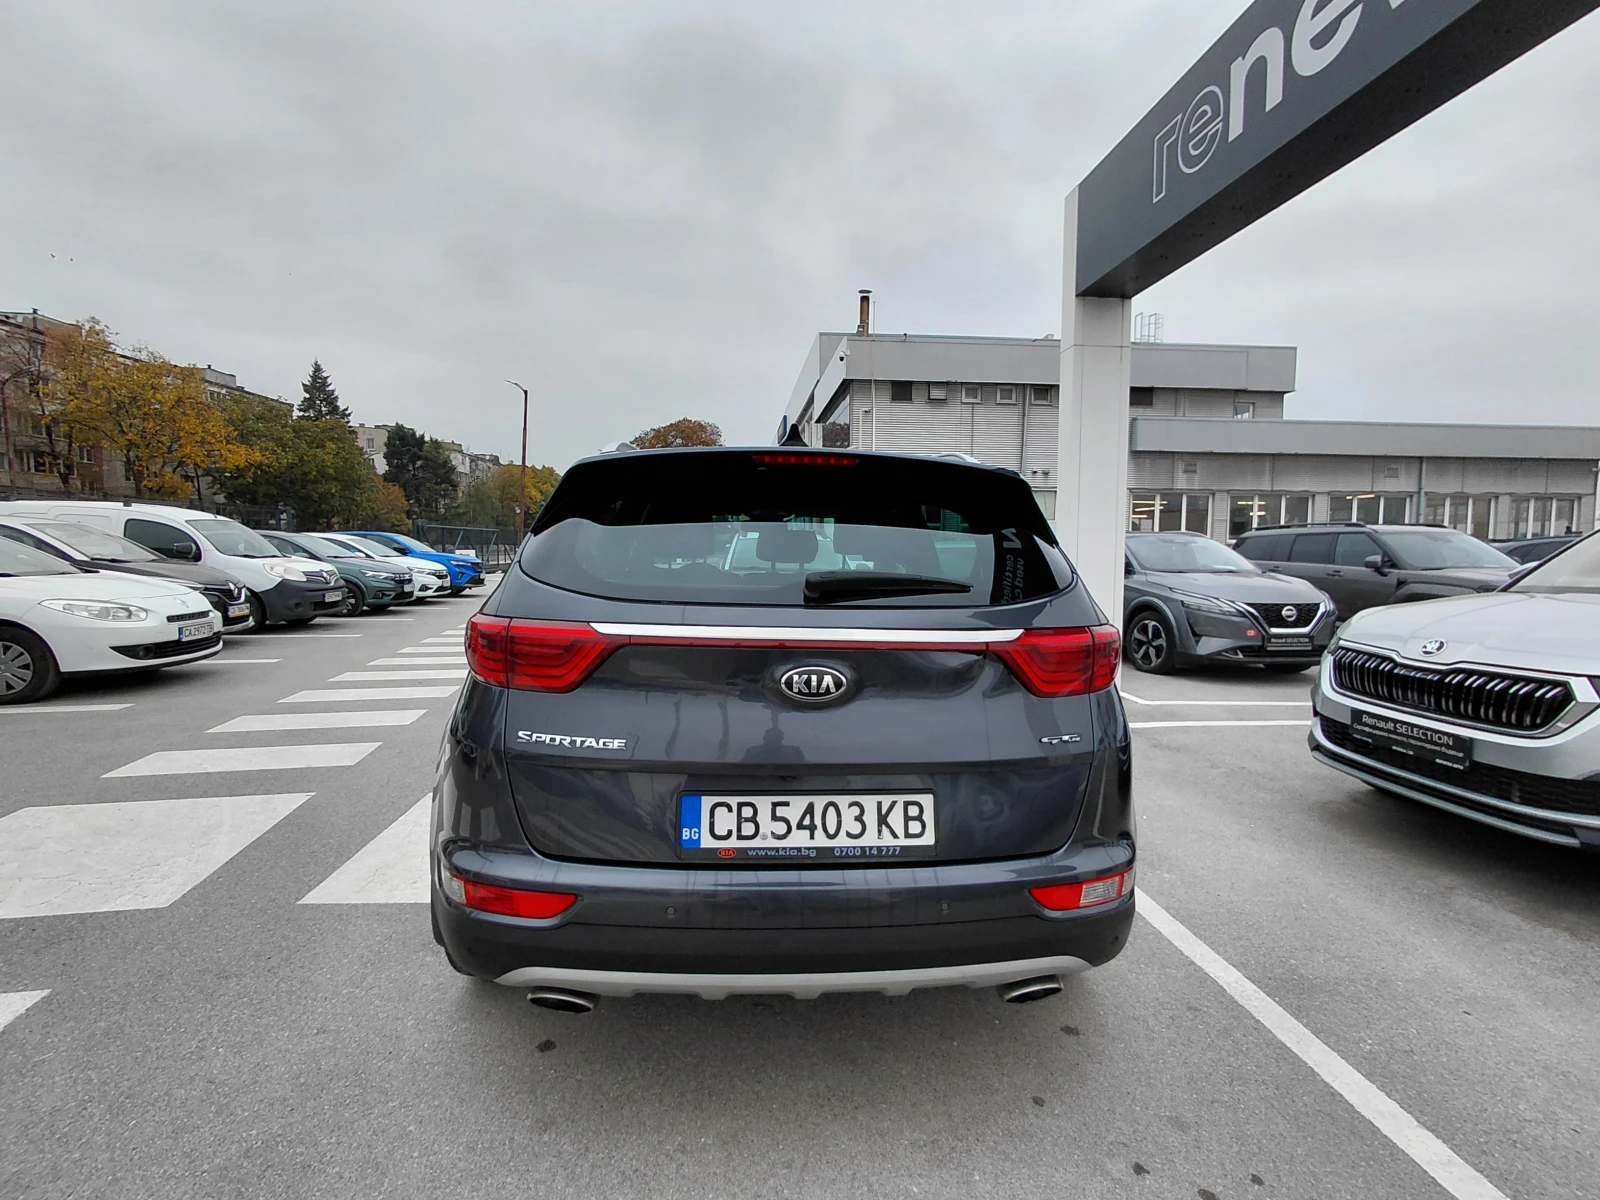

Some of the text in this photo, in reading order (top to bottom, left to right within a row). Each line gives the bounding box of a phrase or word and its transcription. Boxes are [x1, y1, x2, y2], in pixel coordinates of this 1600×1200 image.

[1153, 0, 1401, 203] rene
[791, 674, 836, 693] KIA
[1362, 714, 1395, 731] Renault
[1395, 723, 1453, 746] SELECTION
[516, 730, 627, 750] SPORTAGE
[682, 828, 700, 840] BG
[747, 847, 817, 857] www.kia.bg
[834, 847, 861, 856] 0700
[865, 847, 878, 856] 14
[880, 847, 901, 855] 777
